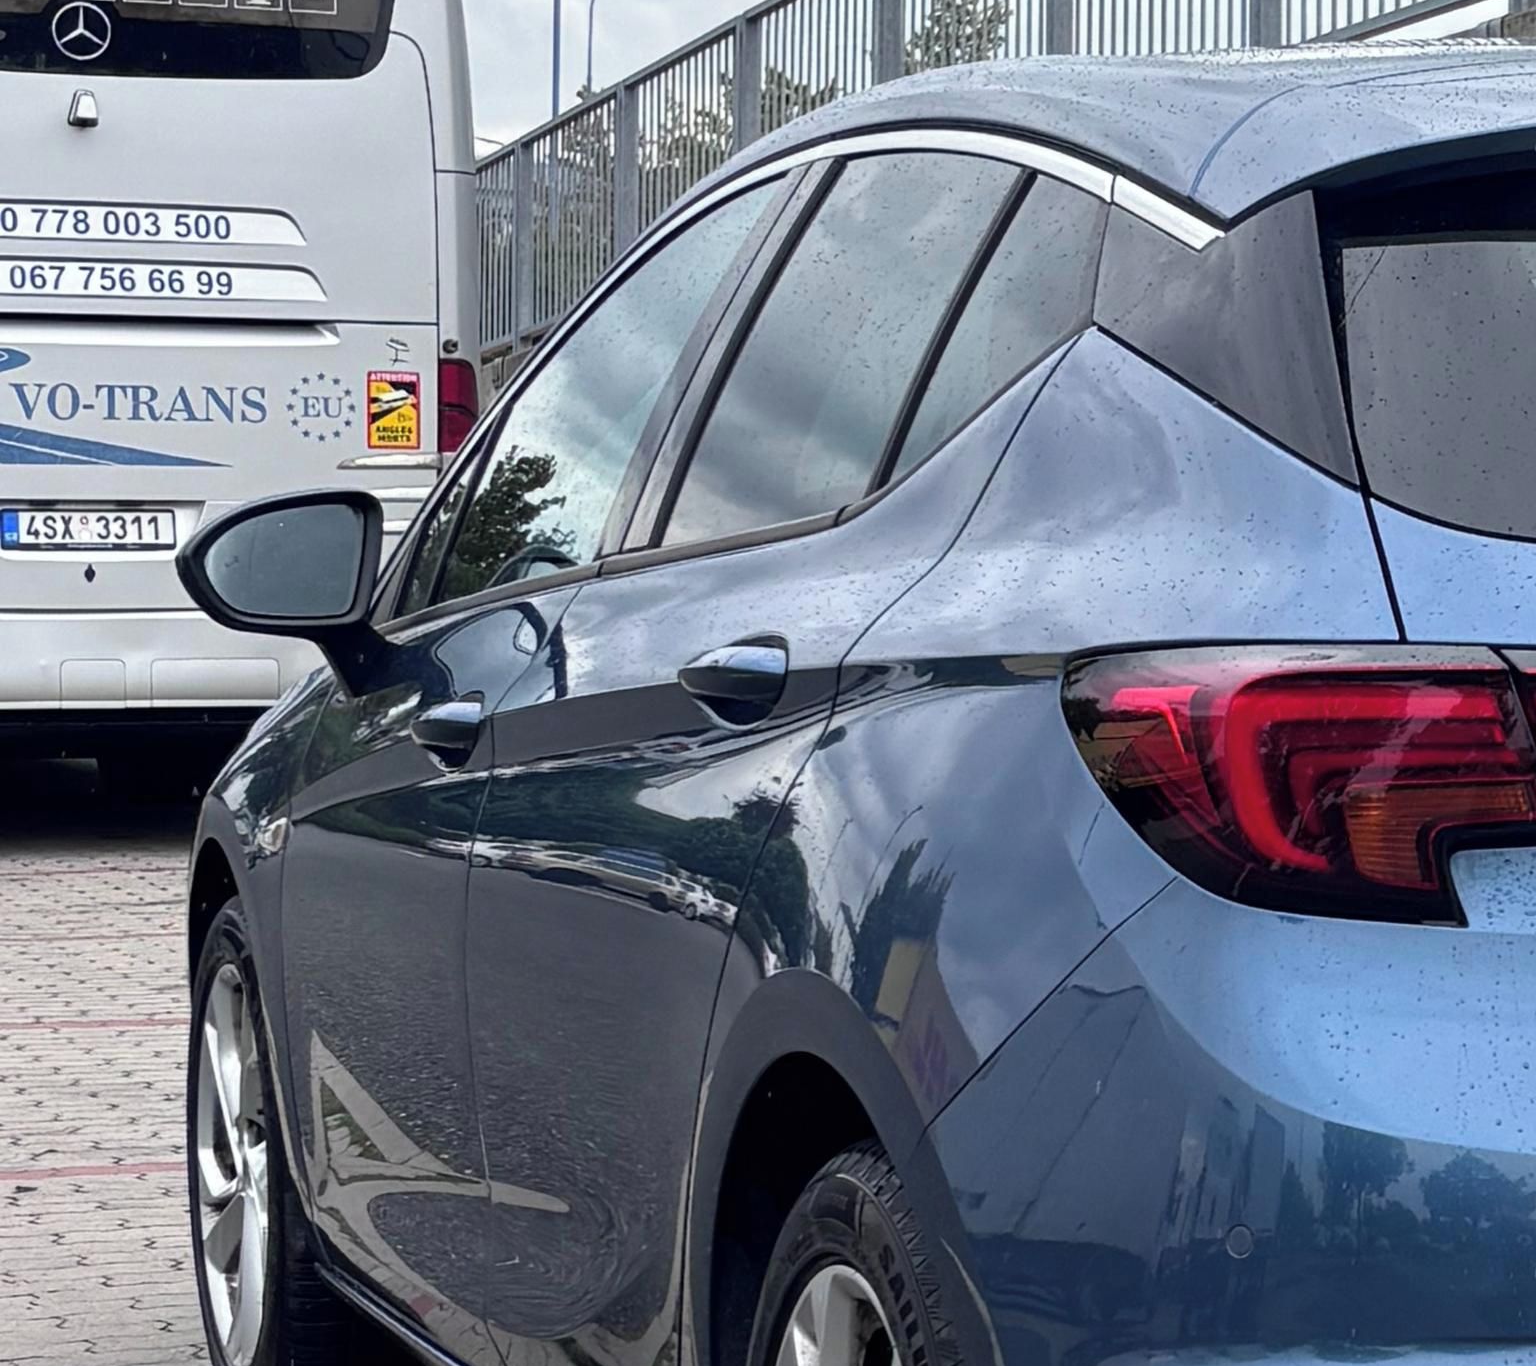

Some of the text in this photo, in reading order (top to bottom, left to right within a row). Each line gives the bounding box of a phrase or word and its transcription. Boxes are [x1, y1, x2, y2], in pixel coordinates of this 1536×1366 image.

[30, 208, 90, 234] 778
[103, 210, 161, 236] 003
[174, 213, 231, 239] 500
[9, 265, 233, 296] 067 756 66 99
[9, 383, 267, 423] VO-TRANS
[301, 396, 344, 418] EU
[26, 515, 160, 541] 4SX 3311
